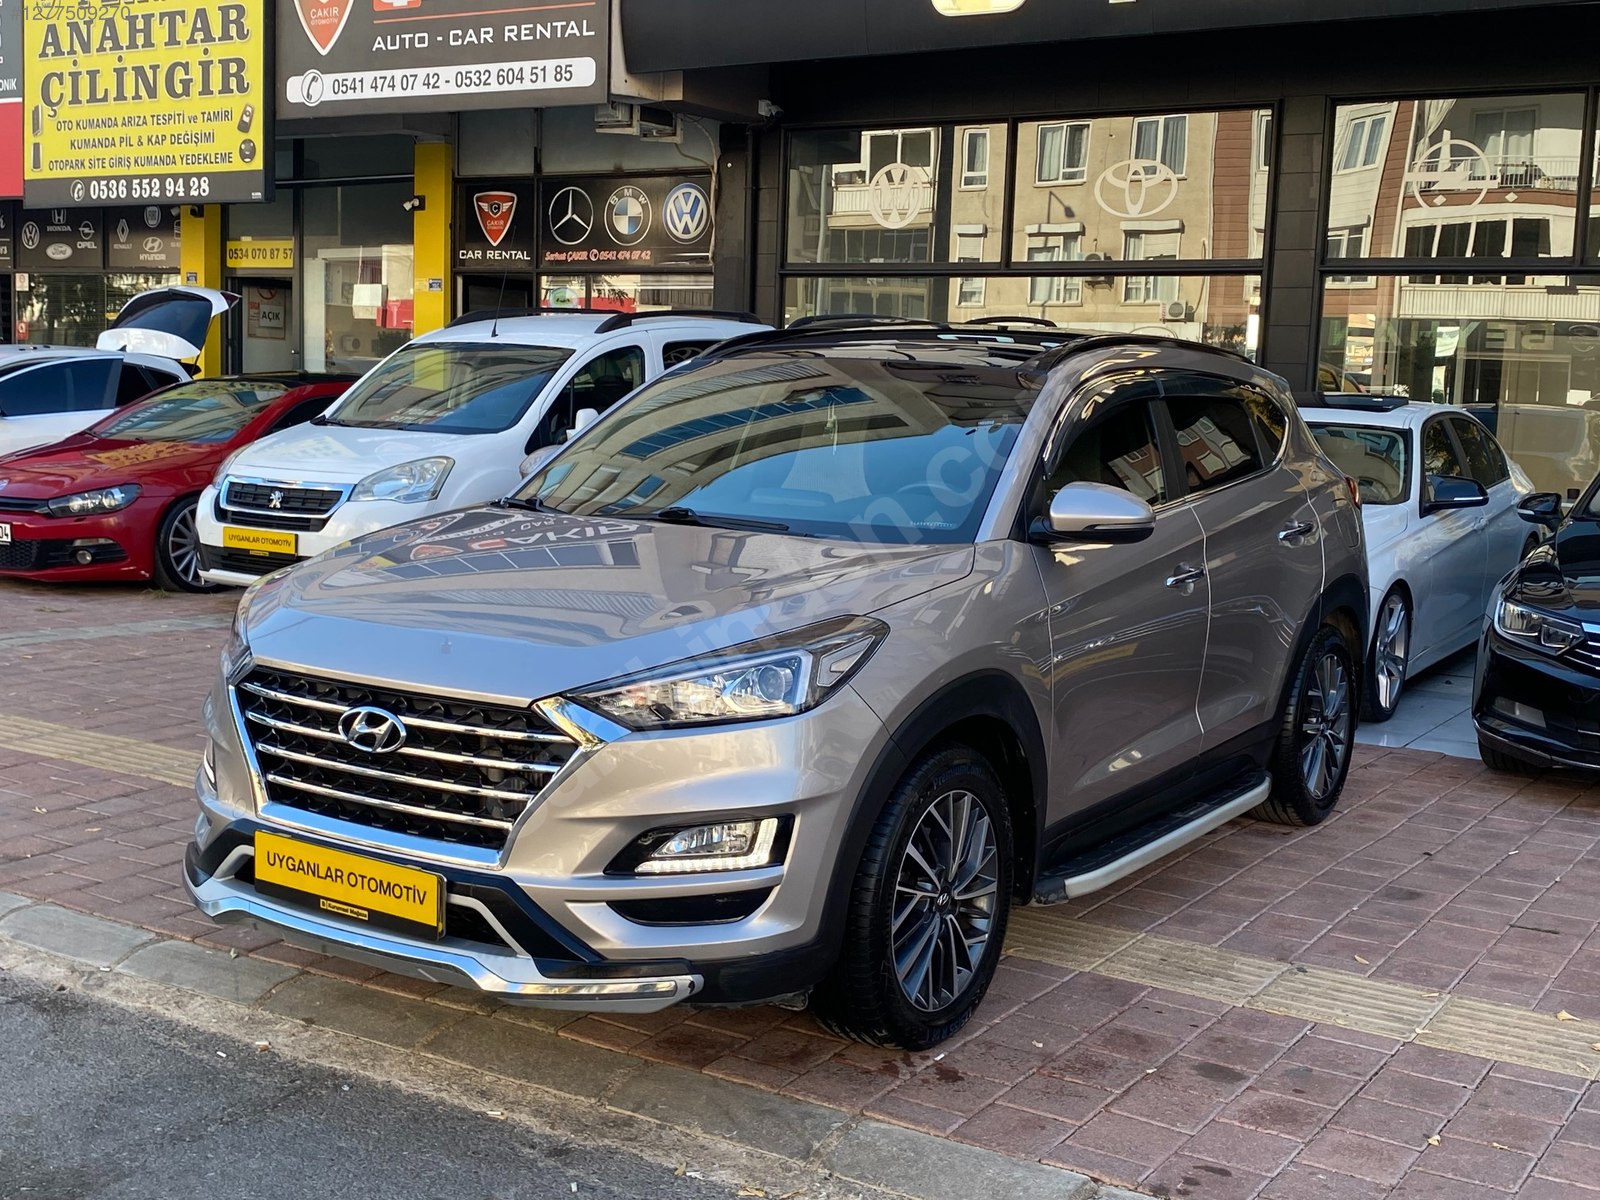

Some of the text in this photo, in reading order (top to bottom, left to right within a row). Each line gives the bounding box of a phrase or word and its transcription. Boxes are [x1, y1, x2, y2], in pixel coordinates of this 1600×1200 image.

[39, 4, 250, 58] ANAHTAR
[372, 32, 429, 51] AUTO
[449, 27, 494, 46] CAR
[504, 19, 595, 42] RENTAL
[41, 47, 250, 118] ÇİLİNGİR
[332, 76, 364, 95] 0541
[370, 75, 396, 93] 474
[400, 74, 418, 91] 07
[422, 72, 441, 90] 42
[455, 69, 492, 88] 0532
[496, 67, 525, 85] 604
[529, 65, 547, 83] 51
[554, 64, 573, 83] 85
[56, 107, 233, 132] OTO KUMANDA ARIZA TESPİTİ ve TAMİRİ
[70, 129, 215, 150] KUMANDA PİL & KAP DEĞİŞİMİ
[48, 152, 233, 171] OTOPARK SİTE GİRİŞ KUMANDA YEDEKLEME
[90, 176, 210, 199] 0536 552 94 28
[76, 241, 98, 249] OPEL
[228, 248, 293, 260] 0534 070 87 57
[459, 250, 531, 260] CAR RENTAL
[261, 311, 281, 322] AÇIK
[228, 533, 292, 547] UYGANLAR OTOMOTİV
[266, 851, 427, 906] UYGANLAR OTOMOTİV
